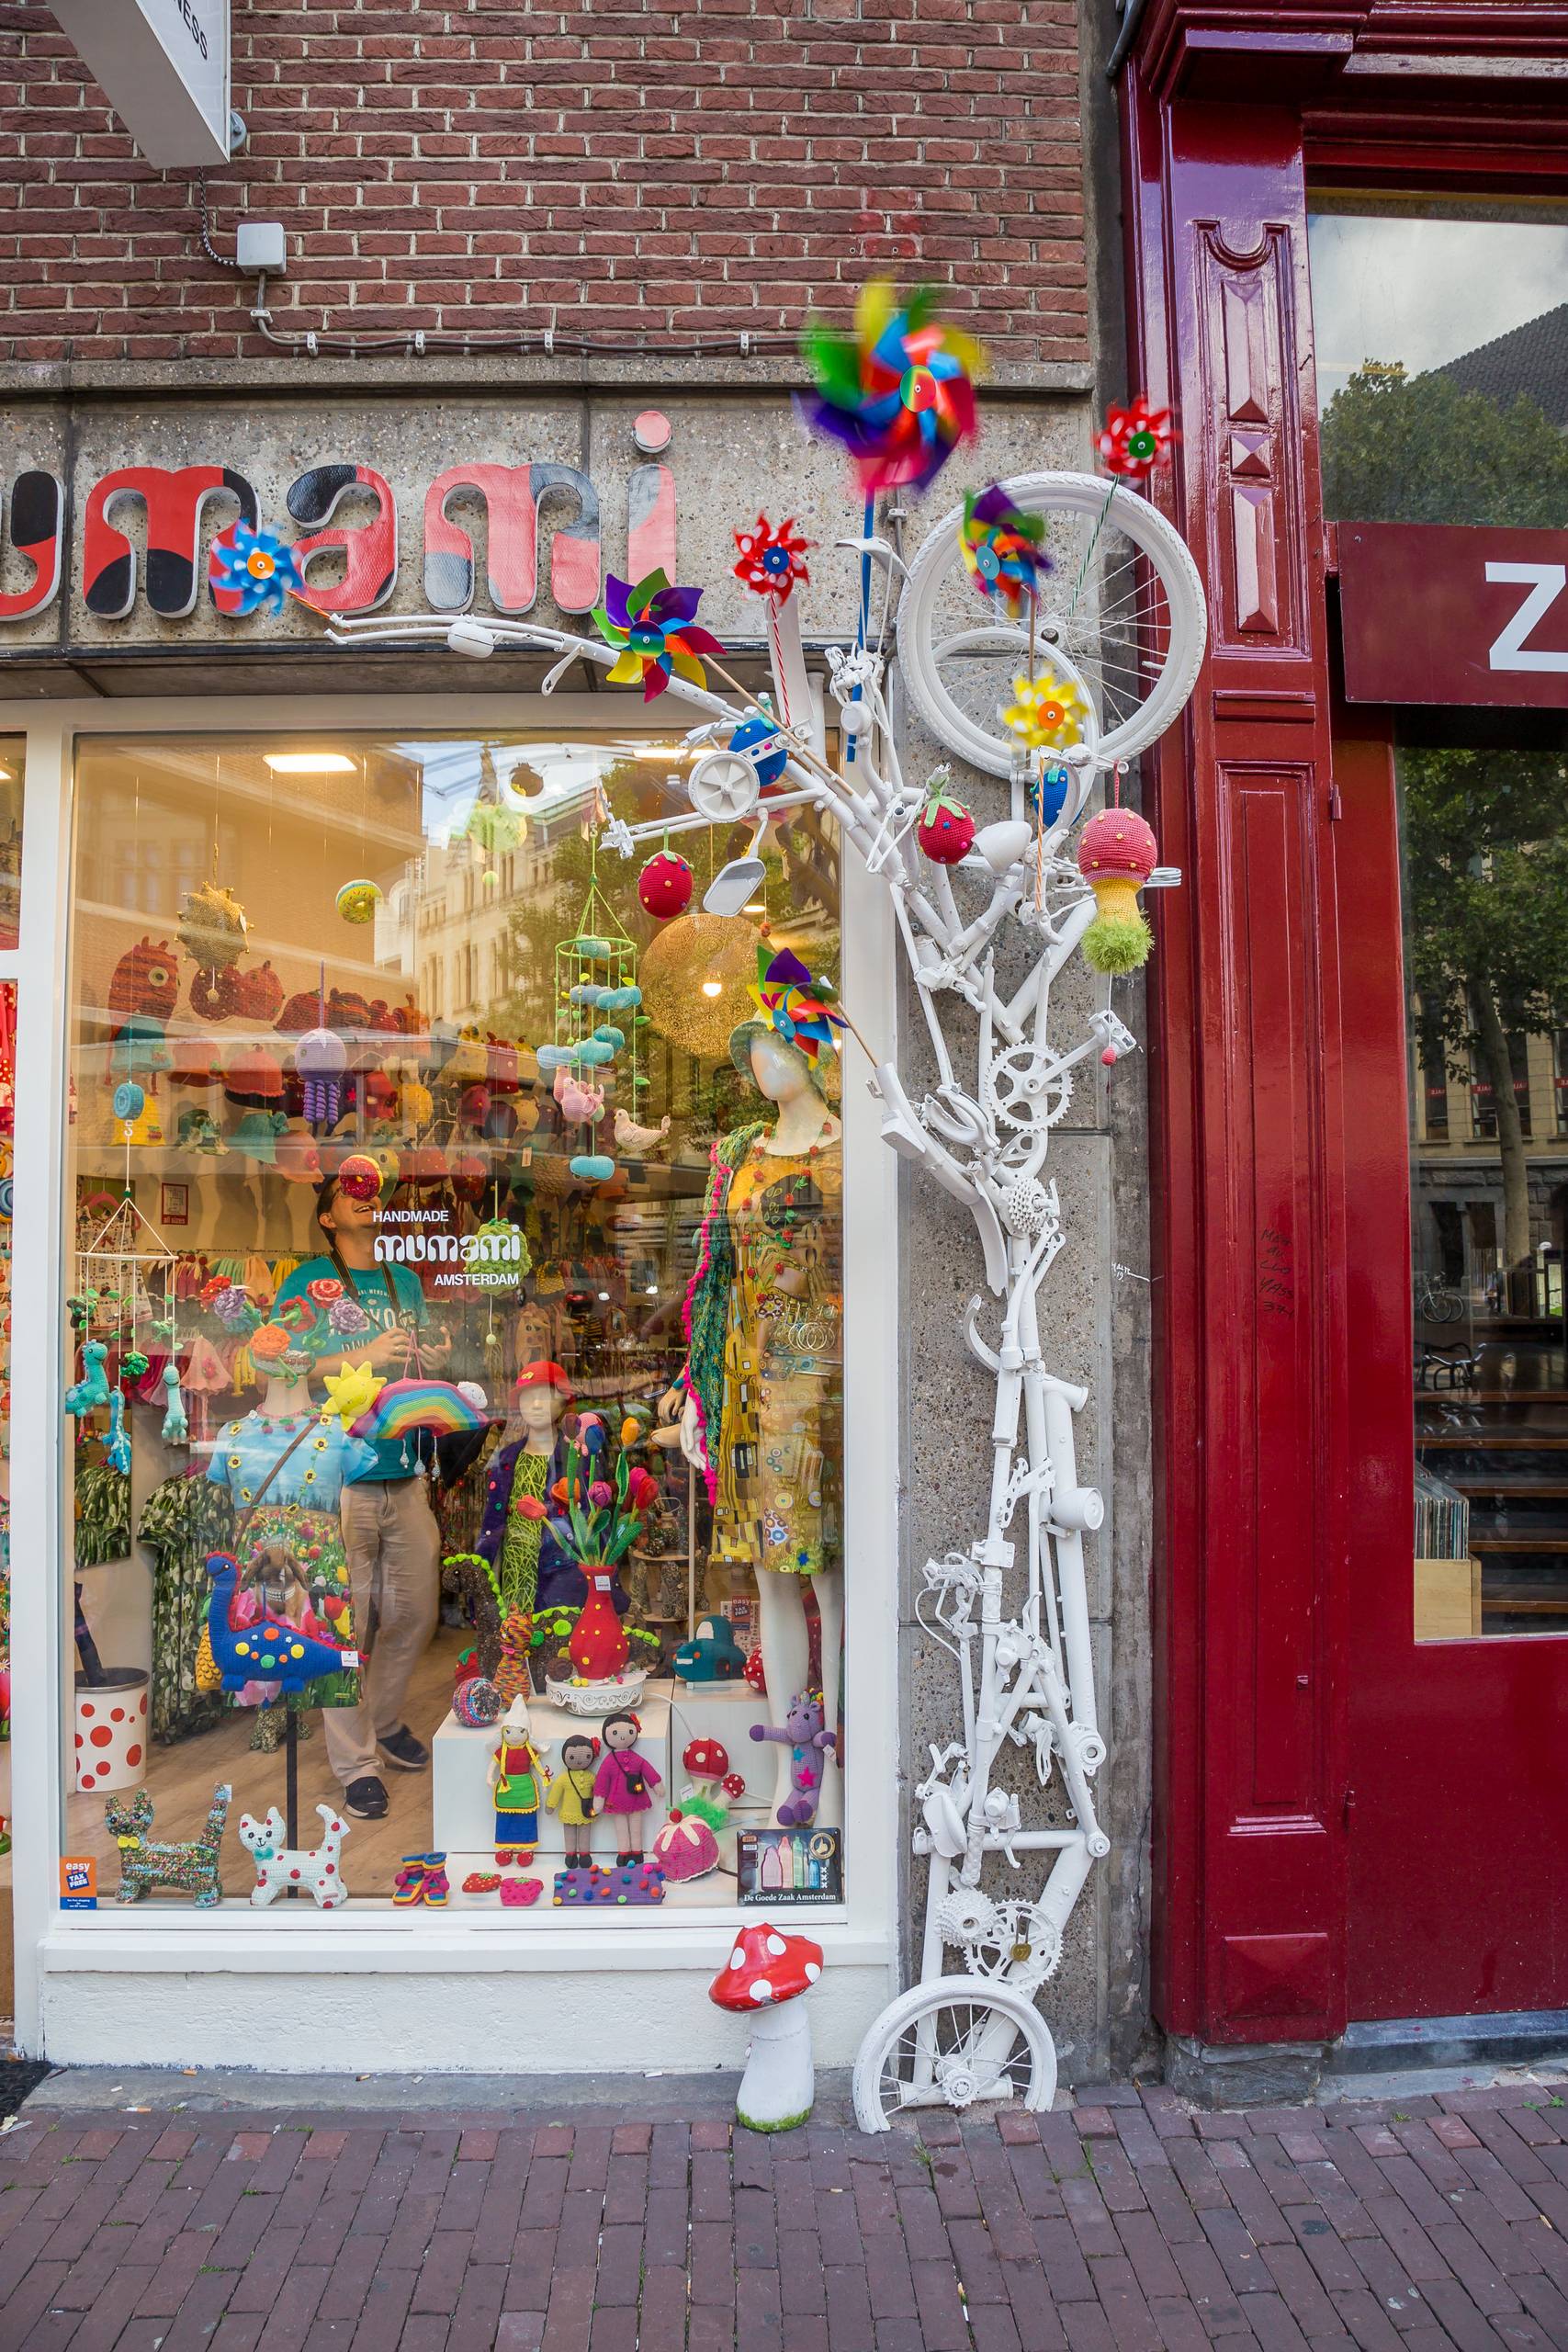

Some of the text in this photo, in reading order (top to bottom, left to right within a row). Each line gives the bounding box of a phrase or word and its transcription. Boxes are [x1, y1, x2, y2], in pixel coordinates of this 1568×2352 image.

[1484, 561, 1568, 673] Z
[373, 1210, 449, 1222] HANDMADE
[374, 1224, 521, 1262] mumami
[434, 1273, 519, 1286] AMSTERDAM
[66, 1863, 90, 1872] easy
[68, 1873, 85, 1883] TAX
[69, 1879, 88, 1888] FREE
[755, 1894, 776, 1902] Goede
[796, 1893, 836, 1901] Amsterdam
